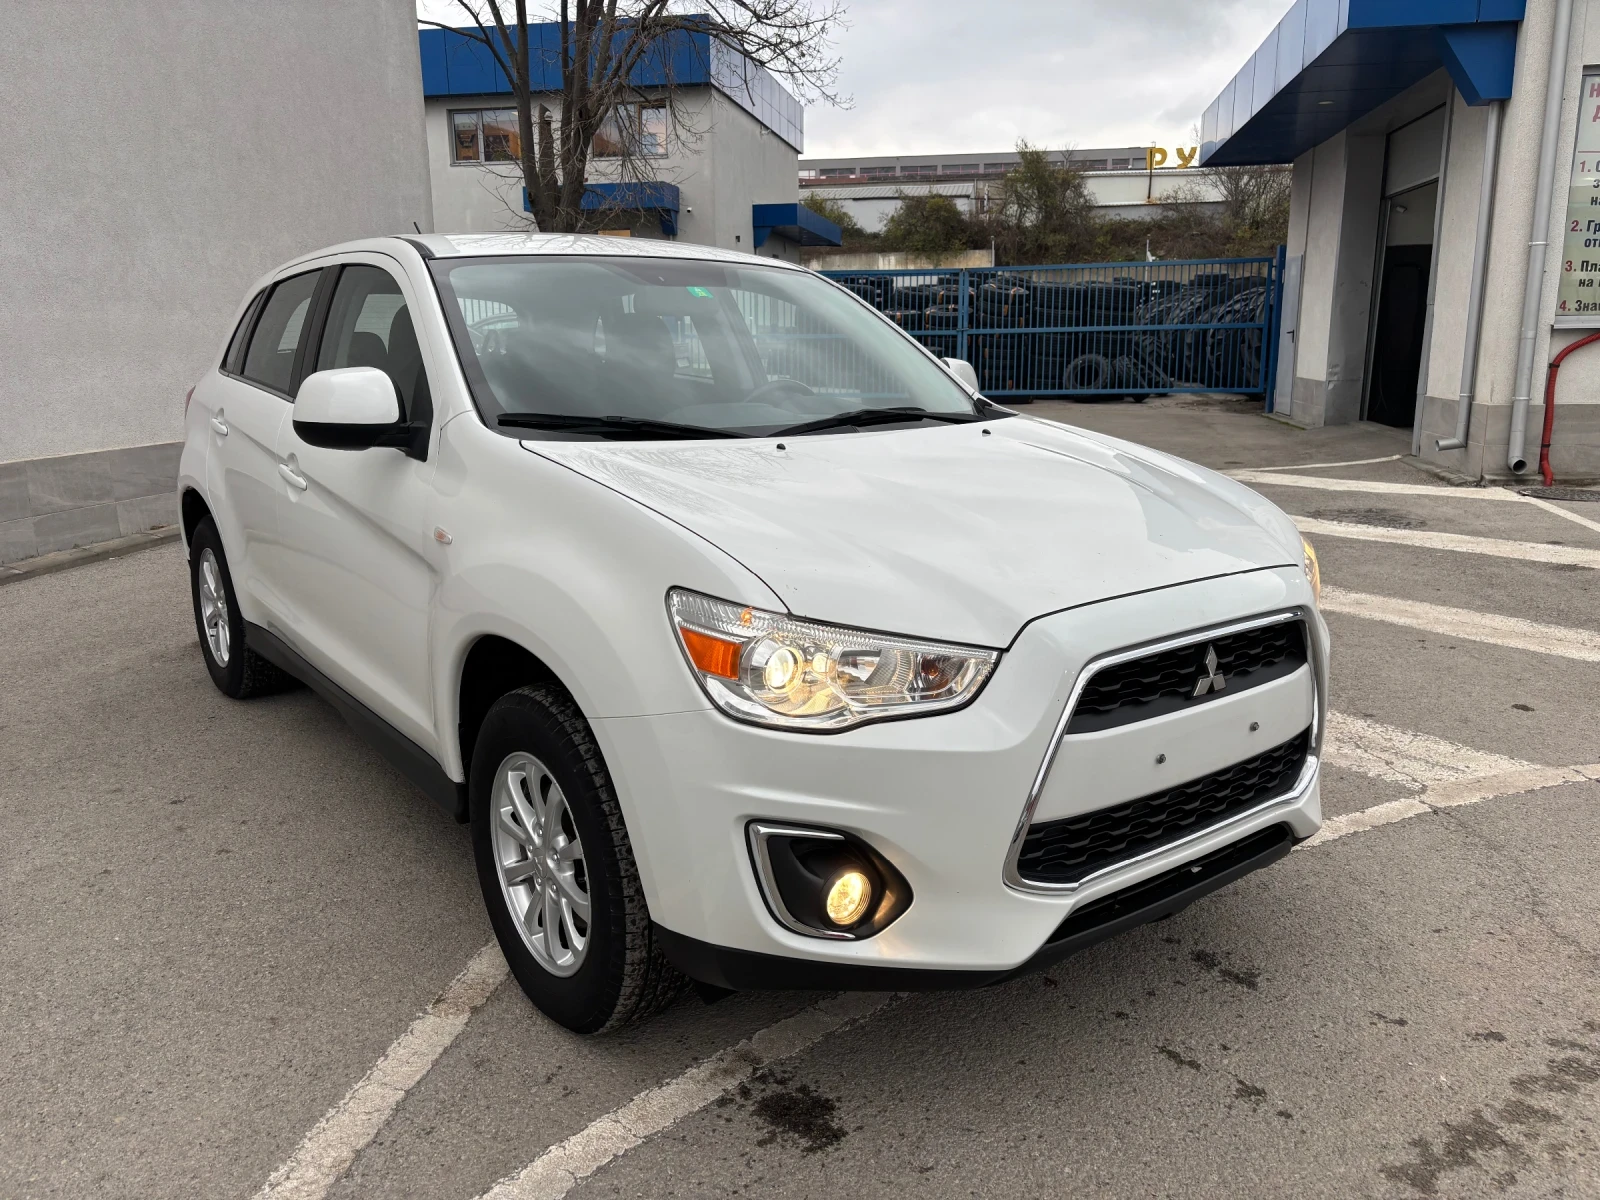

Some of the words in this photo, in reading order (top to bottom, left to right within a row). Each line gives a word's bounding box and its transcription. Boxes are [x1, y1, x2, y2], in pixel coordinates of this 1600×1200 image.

[1570, 219, 1583, 232] 2.
[1565, 260, 1577, 272] 3.
[1578, 278, 1594, 288] на
[1559, 299, 1571, 312] 4.
[1574, 299, 1600, 312] Зна
